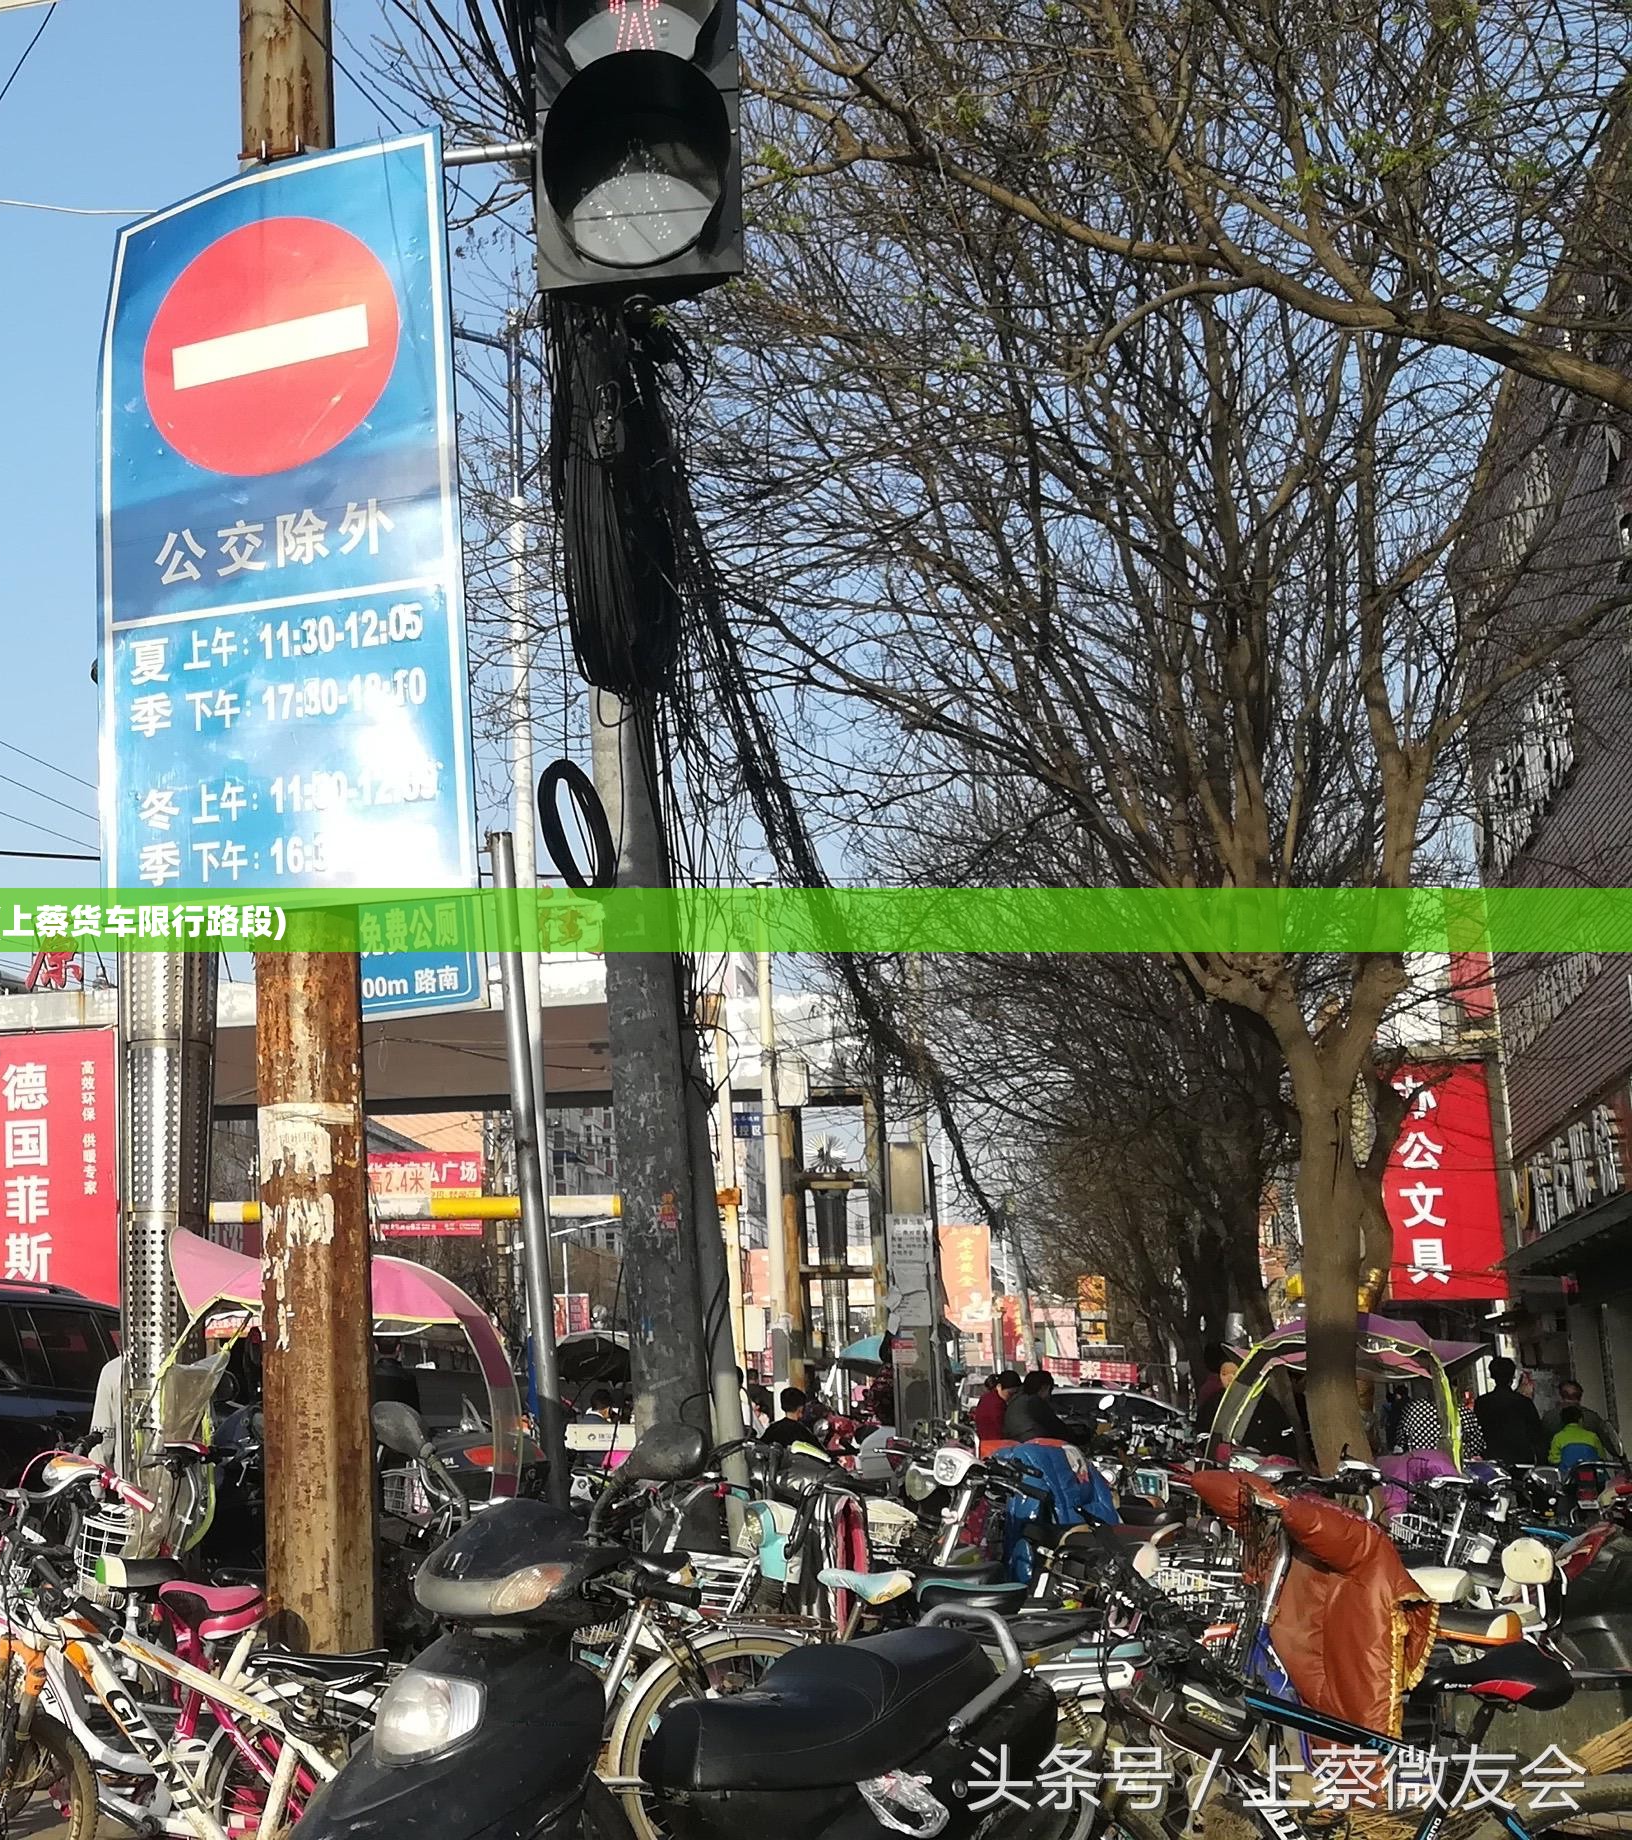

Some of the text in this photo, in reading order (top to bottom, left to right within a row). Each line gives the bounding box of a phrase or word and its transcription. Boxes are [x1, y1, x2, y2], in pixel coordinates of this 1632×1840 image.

[156, 498, 396, 588] 公交除外
[361, 965, 460, 998] 00m 路南
[81, 1060, 97, 1122] 高效环保
[2, 1062, 54, 1283] 德国菲斯
